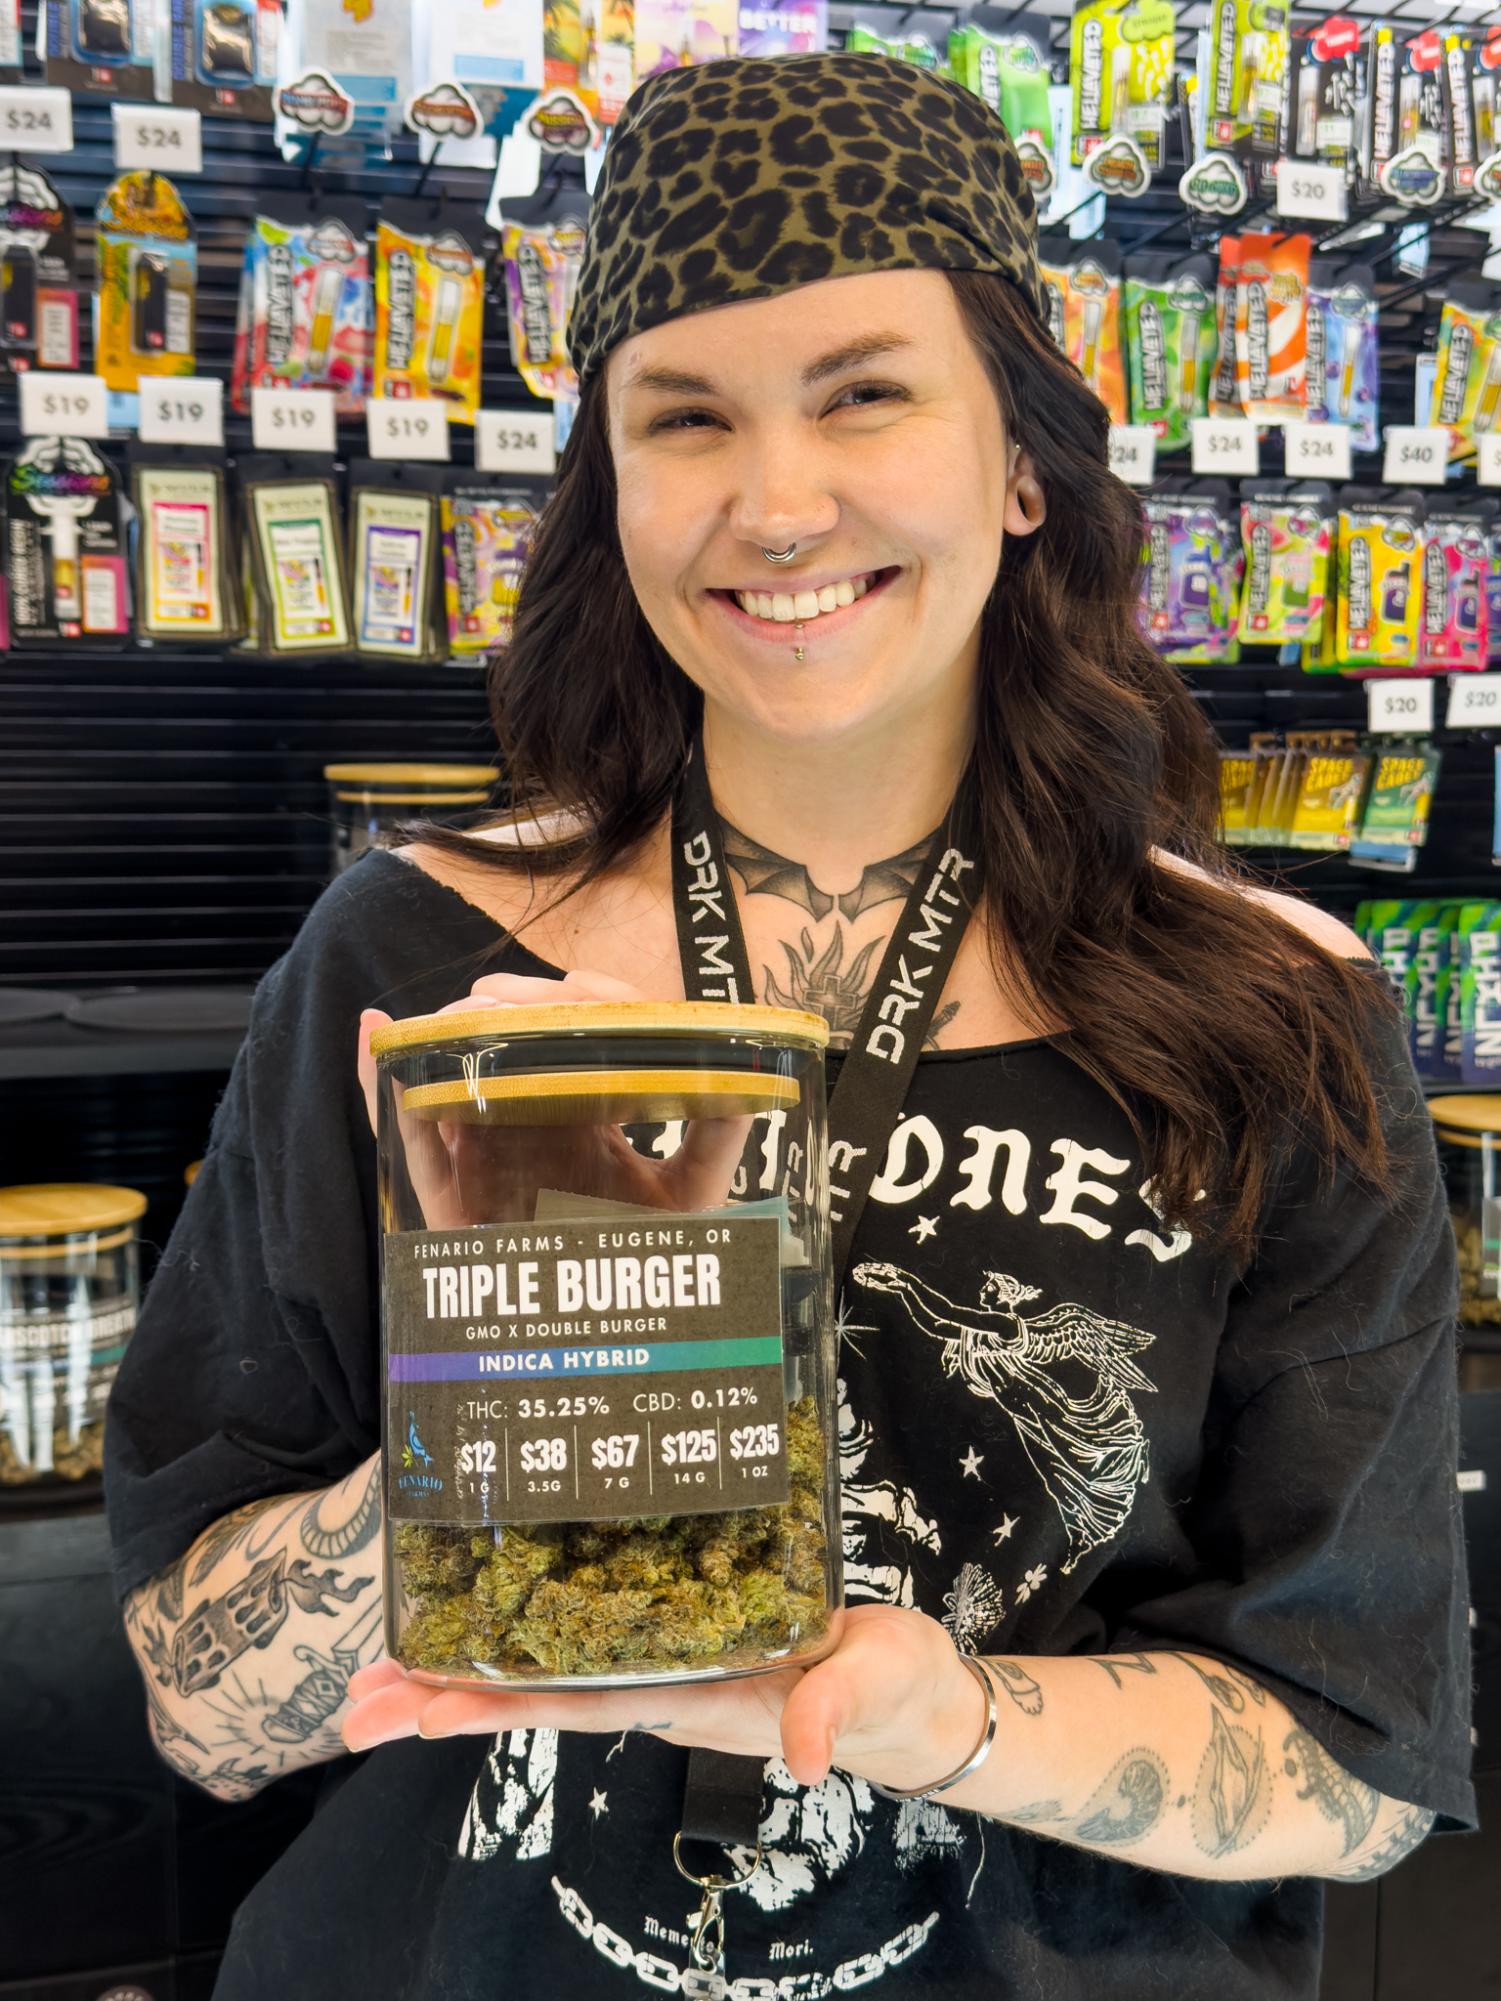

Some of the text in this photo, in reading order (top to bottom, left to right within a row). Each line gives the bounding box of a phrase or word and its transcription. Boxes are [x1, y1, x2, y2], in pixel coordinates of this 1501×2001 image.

[6, 108, 53, 131] $24
[136, 125, 183, 149] $24
[1291, 180, 1326, 200] $20
[43, 393, 90, 415] $19
[158, 400, 204, 422] $19
[271, 407, 316, 429] $19
[386, 416, 430, 438] $19
[497, 429, 538, 451] $24
[1208, 435, 1242, 453] $24
[1300, 439, 1334, 457] $24
[1399, 445, 1433, 463] $40
[1385, 697, 1417, 714] $20
[1465, 691, 1498, 708] $20
[1310, 756, 1354, 774] SPACE
[1382, 756, 1426, 775] SPACE
[683, 830, 740, 1005] DRK MT
[865, 847, 975, 1065] DRK MTR
[414, 1239, 485, 1259] FENARIO
[496, 1235, 565, 1255] FARMS
[598, 1229, 695, 1249] EUGENE,
[706, 1228, 732, 1245] OR
[422, 1253, 722, 1319] TRIPLE BURGER
[465, 1317, 668, 1341] GMO X DOUBLE BURGER
[478, 1348, 651, 1373] INDICA HYBRID
[466, 1386, 759, 1420] THC: 35.25% CBD: 0.12%
[460, 1422, 781, 1474] $12 $38 $67 $125 $235
[527, 1479, 562, 1493] 3.5G
[603, 1478, 611, 1490] 7
[618, 1476, 630, 1490] G
[673, 1472, 687, 1486] 14
[694, 1471, 706, 1485] G
[751, 1464, 769, 1478] OZ
